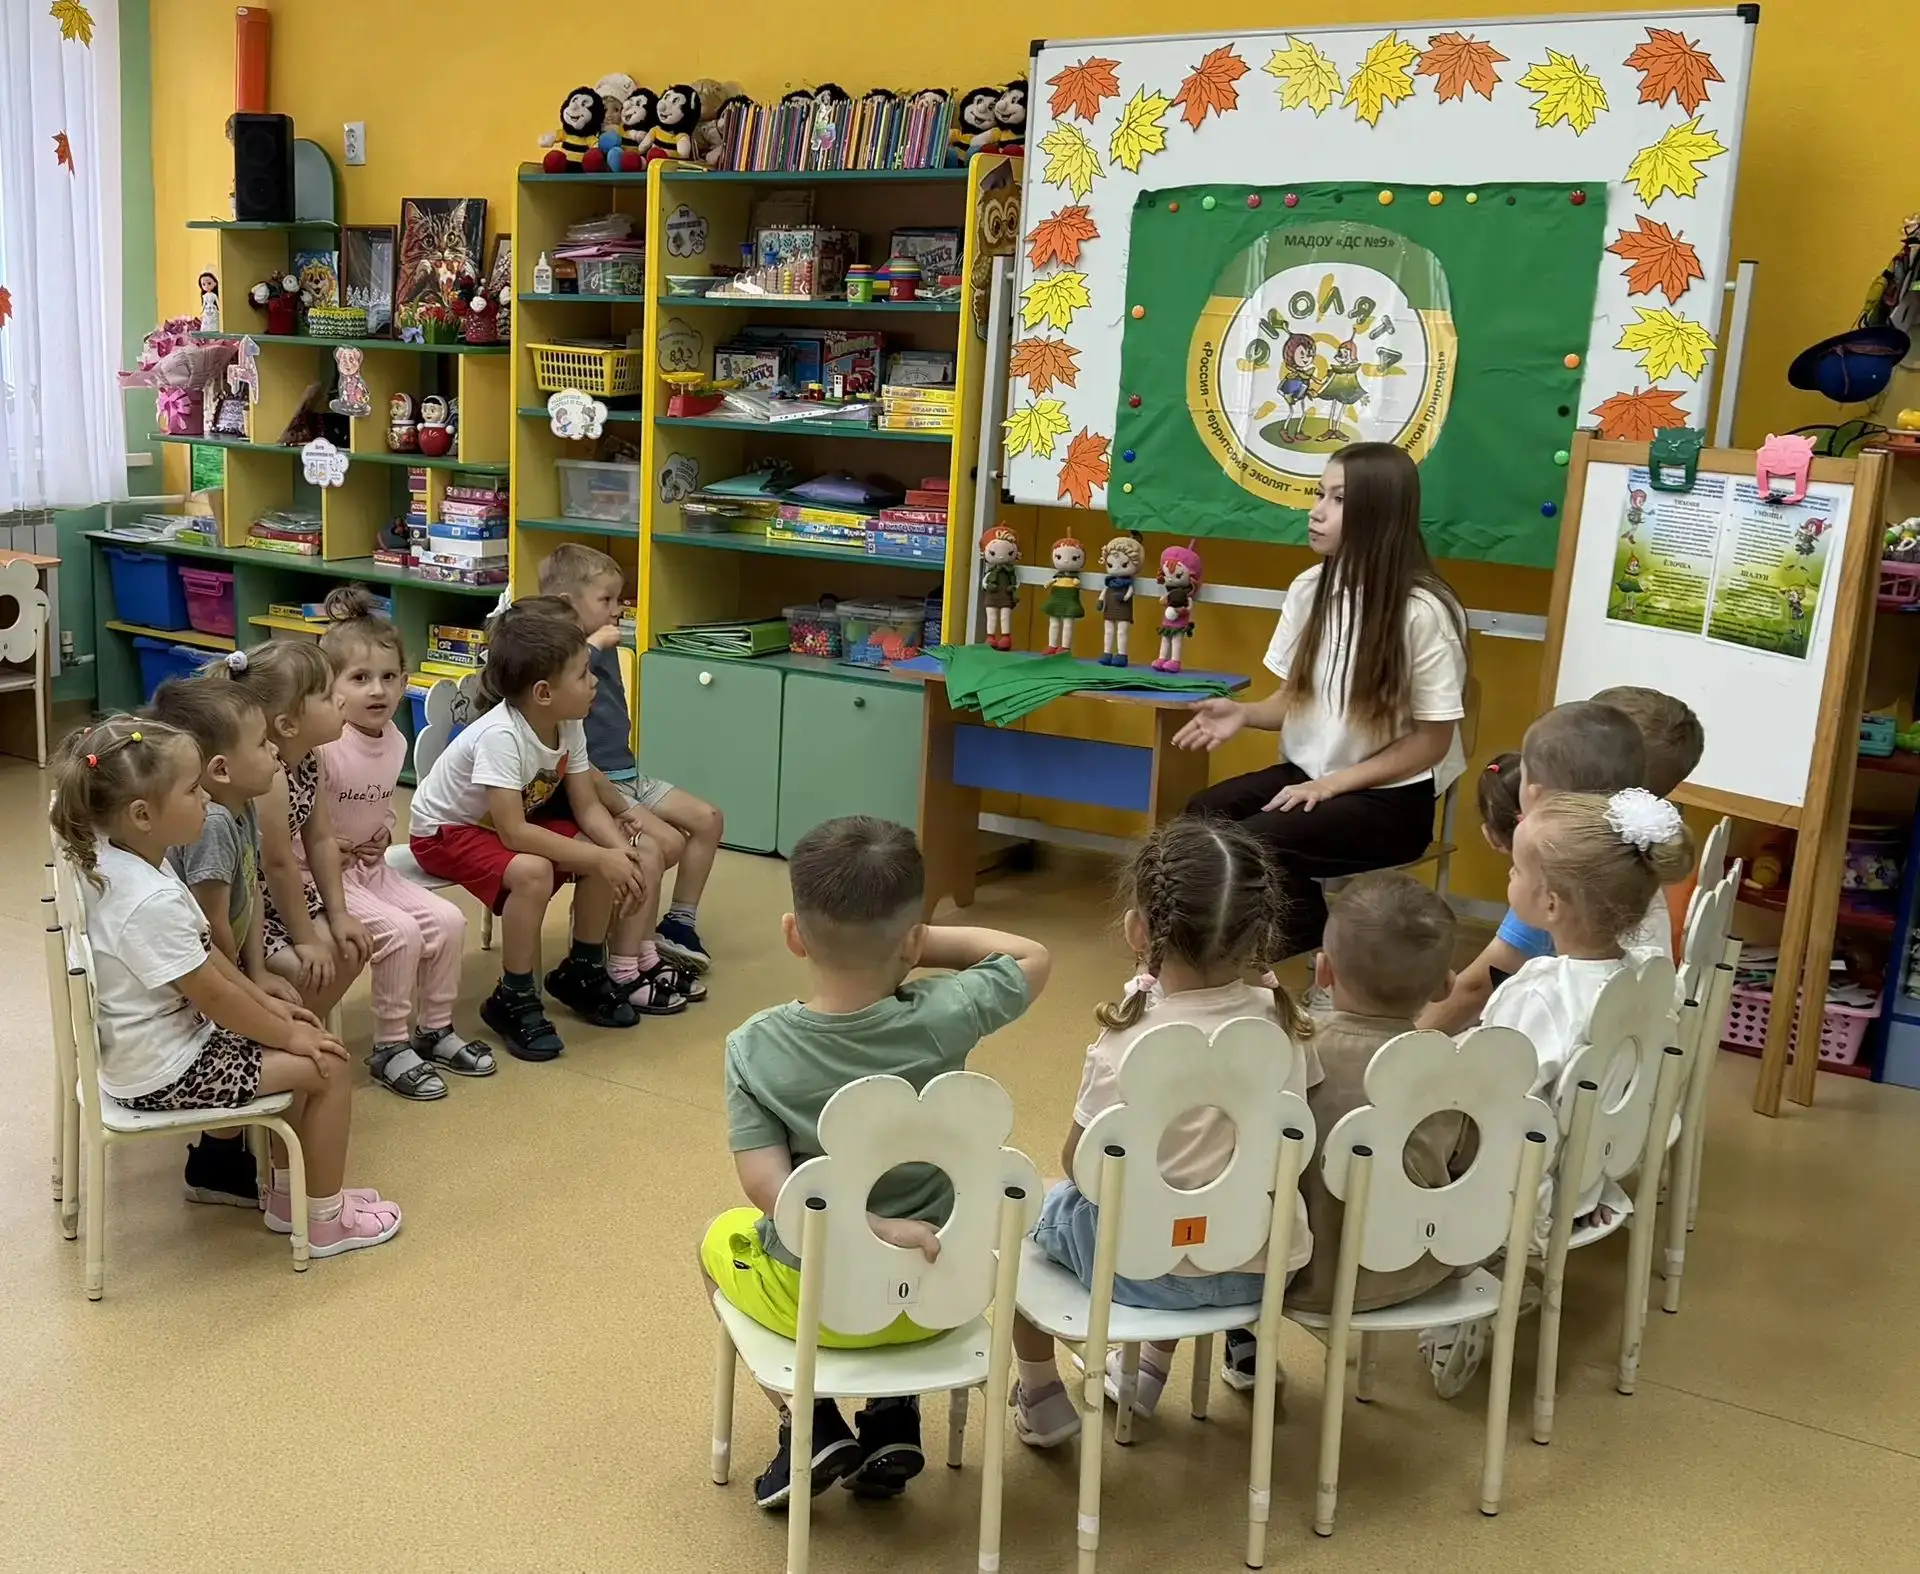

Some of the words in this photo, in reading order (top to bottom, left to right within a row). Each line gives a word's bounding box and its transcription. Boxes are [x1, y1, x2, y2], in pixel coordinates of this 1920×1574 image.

[1284, 235, 1333, 249] МАДОУ
[1336, 235, 1362, 249] «ДС
[1364, 235, 1395, 248] №9»
[1204, 408, 1249, 472] территория
[1425, 1222, 1436, 1238] 0
[898, 1282, 909, 1299] 0
